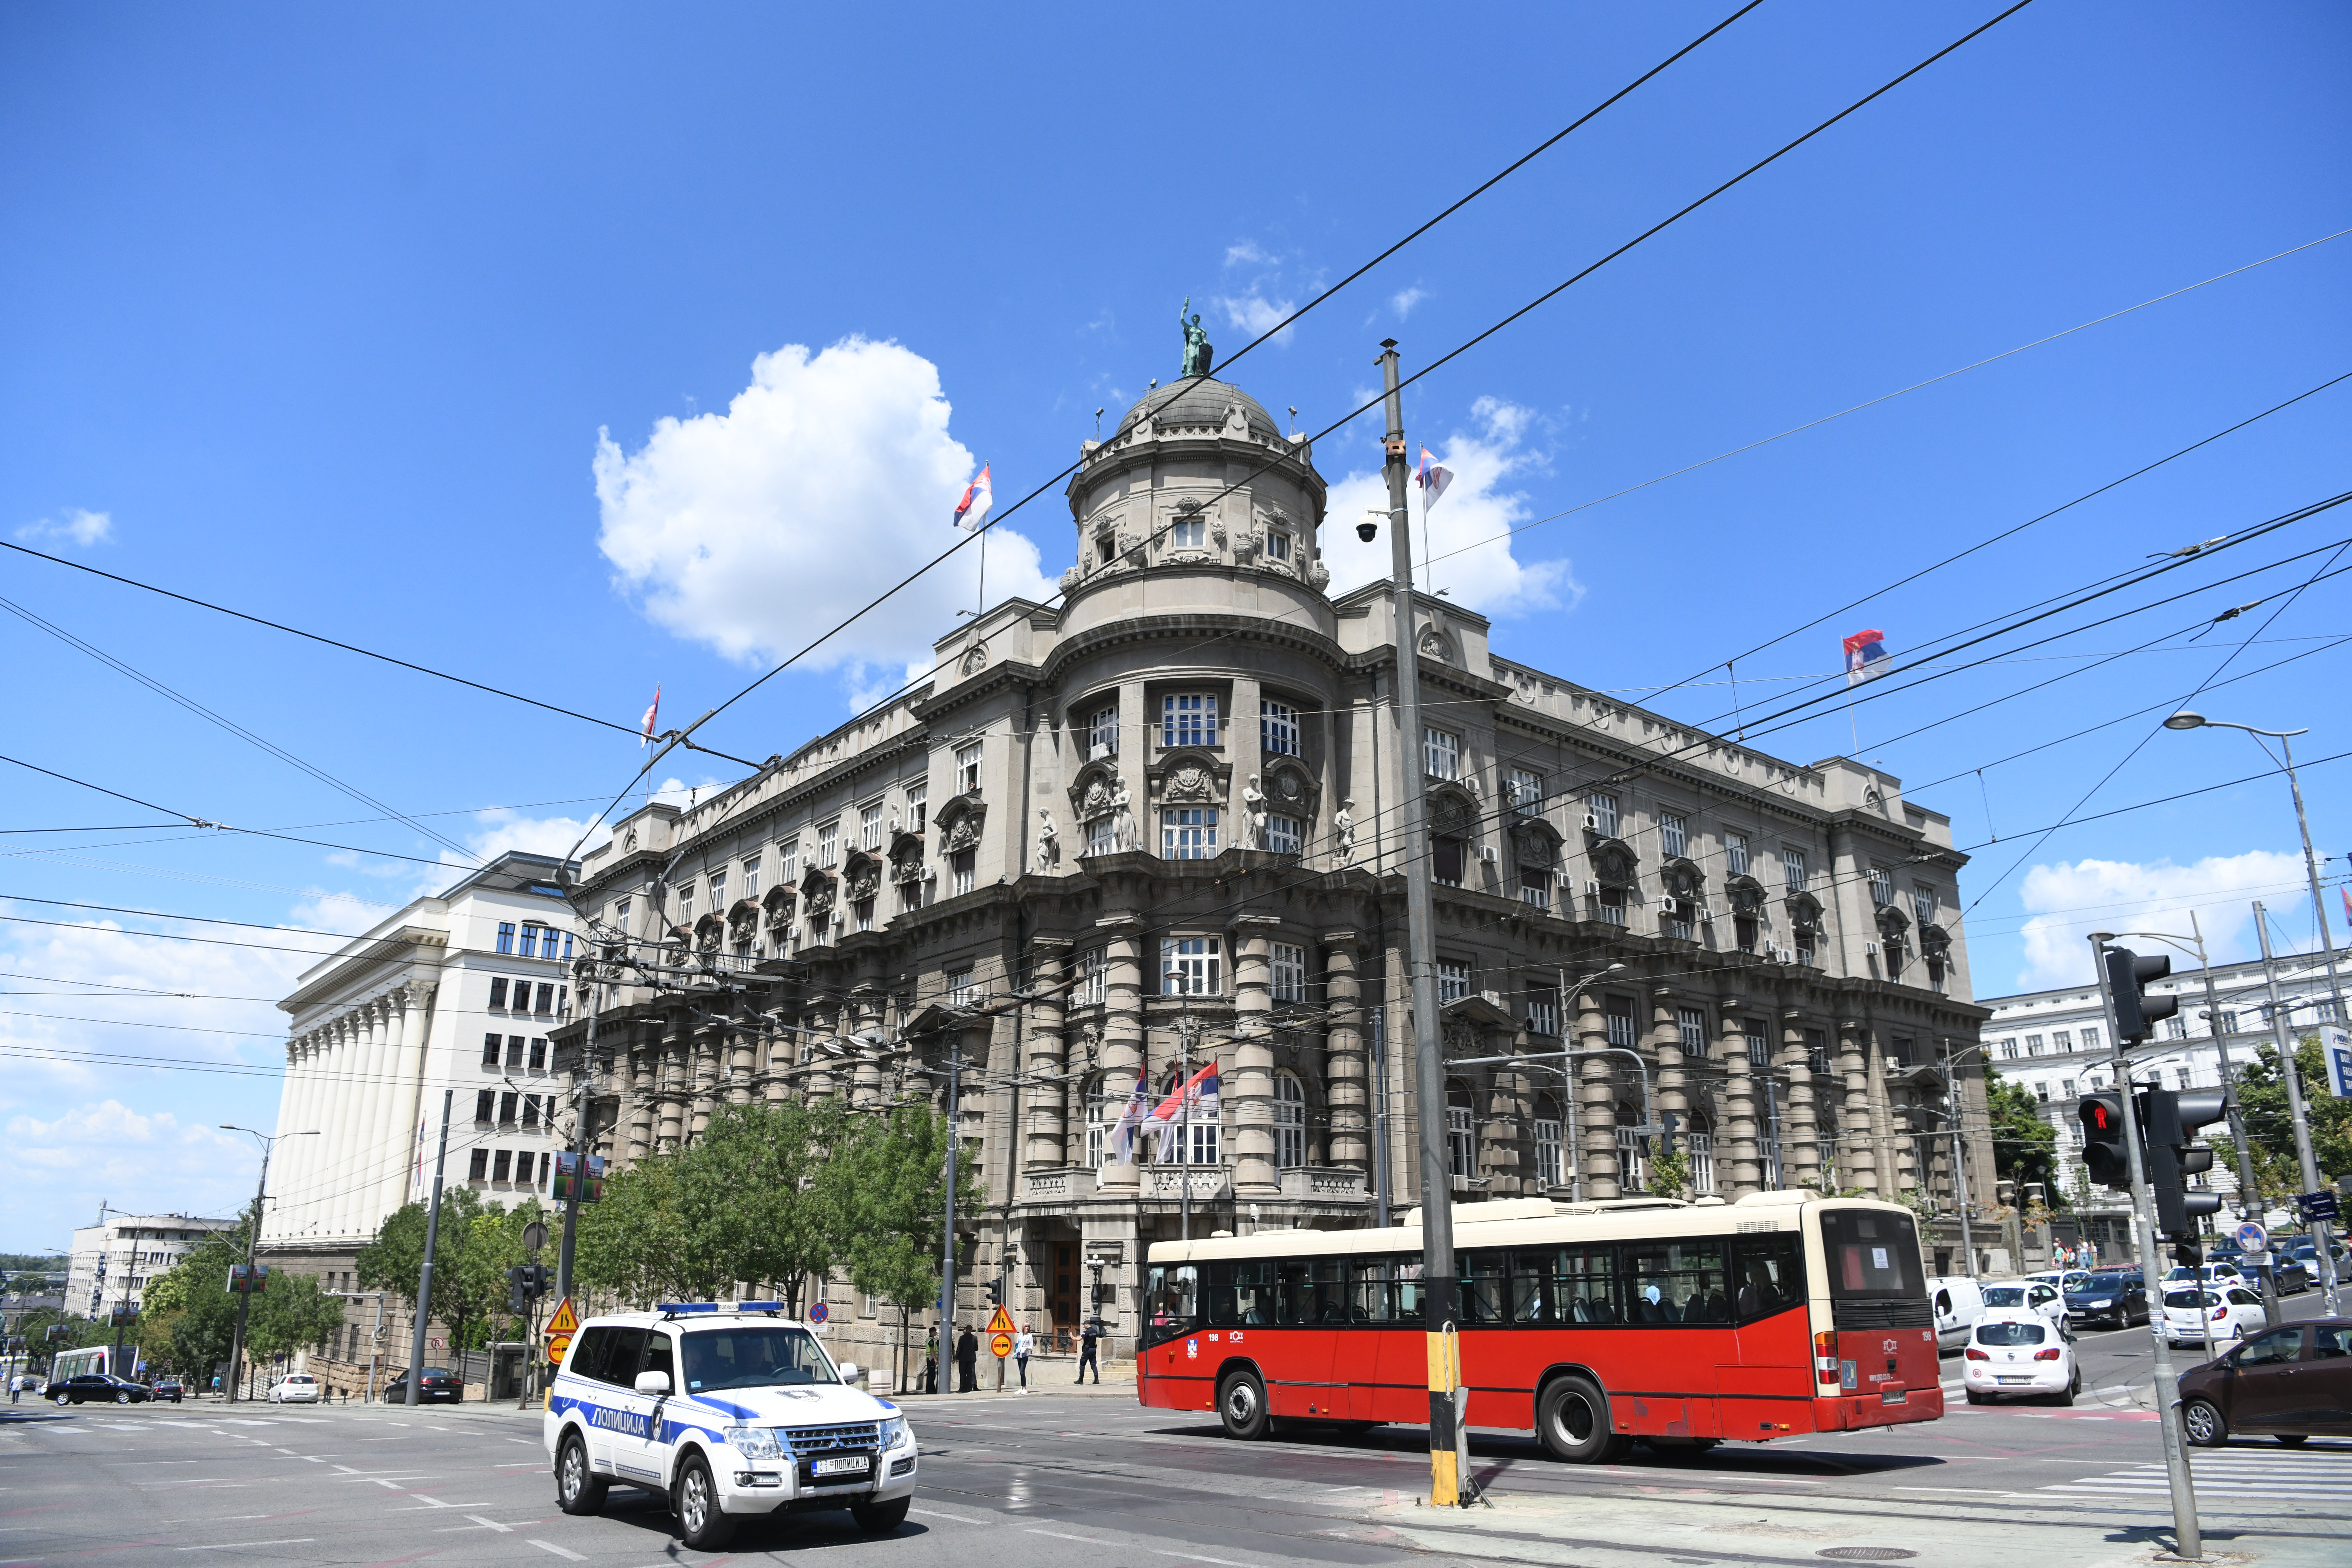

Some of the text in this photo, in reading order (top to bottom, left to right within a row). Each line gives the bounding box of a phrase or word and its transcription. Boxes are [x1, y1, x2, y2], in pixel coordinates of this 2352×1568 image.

[89, 1252, 105, 1322] HOTEL BEOGRA
[1922, 1331, 1932, 1341] 198
[1869, 1373, 1890, 1383] www.gsp.co.rs
[591, 1408, 645, 1435] ПОЛИЦИЈА
[835, 1457, 867, 1470] ПОЛИЦИЈА
